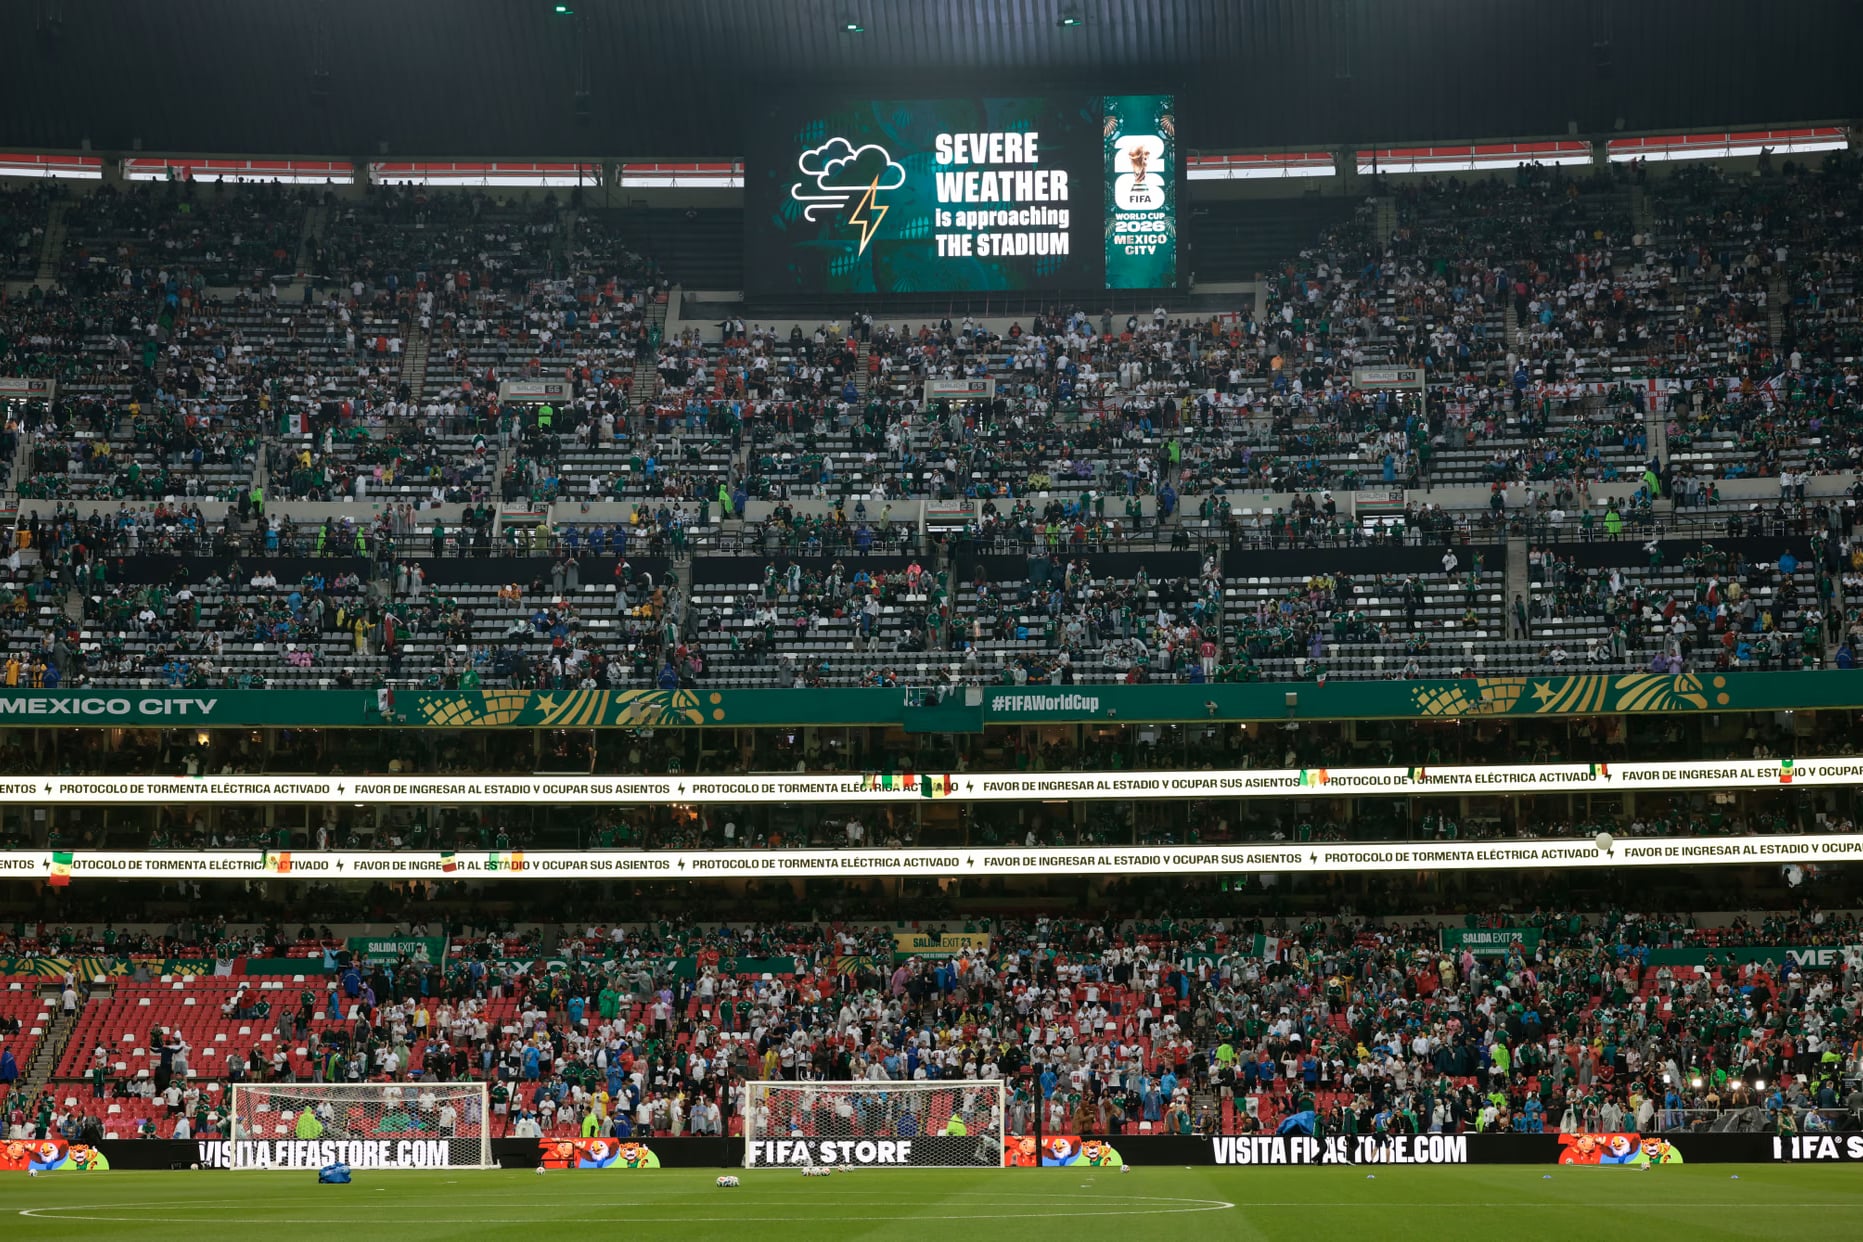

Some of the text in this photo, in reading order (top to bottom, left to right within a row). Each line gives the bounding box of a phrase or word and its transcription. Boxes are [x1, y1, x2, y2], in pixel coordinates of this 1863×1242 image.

[935, 132, 1038, 165] SEVERE
[935, 170, 1069, 203] WEATHER
[1129, 195, 1151, 203] FIFA
[935, 205, 1070, 230] is approaching
[1115, 212, 1165, 221] WORLD CUP
[1115, 221, 1165, 233] 2026
[935, 232, 1069, 257] THE STADIUM
[1113, 235, 1167, 245] MEXICO
[1125, 245, 1156, 255] CITY
[0, 697, 218, 714] MEXICO CITY
[991, 694, 1099, 712] #FIFAWorldCup
[1324, 775, 1391, 786] PROTOCOLO
[1394, 775, 1408, 785] DE
[1475, 773, 1536, 783] ELÉCTRICA
[1539, 772, 1597, 783] ACTIVADO
[1623, 771, 1659, 780] FAVOR
[1663, 771, 1676, 779] DE
[1680, 769, 1737, 779] INGRESAR
[1740, 769, 1755, 778] AL
[1757, 767, 1807, 778] ESTIO
[1809, 768, 1815, 776] Y
[0, 784, 36, 793] ENTOS
[60, 783, 329, 793] PROTOCOLO DE TORMENTA ELÉCTRICA ACTIVADO
[355, 785, 669, 793] FAVOR DE INGRESAR AL ESTADIO Y OCUPAR SUS ASIENTOS
[693, 784, 759, 793] PROTOCOLO
[762, 784, 775, 793] DE
[778, 784, 838, 792] TORMENTA
[984, 778, 1300, 791] FAVOR DE INGRESAR AL ESTADIO Y OCUPAR SUS ASIENTOS
[1325, 849, 1599, 862] PROTOCOLO DE TORMENTA ELÉCTRICA ACTIVADO
[1625, 843, 1863, 857] FAVOR DE INGRESAR AL ESTADIO Y OCUPA
[72, 860, 127, 870] OTOCOLO
[129, 861, 142, 869] DE
[145, 861, 206, 869] TORMENTA
[354, 860, 669, 870] FAVOR DE INGRER AL ESTADIO Y OCUPAR SUS ASIENTOS
[693, 857, 959, 868] PROTOCOLO DE TORMENTA ELÉCTRICA ACTIVADO
[985, 854, 1301, 866] FAVOR DE INGRESAR AL ESTADIO Y OCUPAR SUS ASIENTOS
[942, 937, 961, 947] EXIT
[1462, 932, 1492, 944] SALIDA
[1493, 932, 1510, 943] EXIT
[368, 942, 397, 953] SALIDA
[198, 1140, 449, 1168] VISITA FIFASTORE.COM
[819, 1140, 912, 1163] STORE
[1212, 1136, 1287, 1164] VISITA
